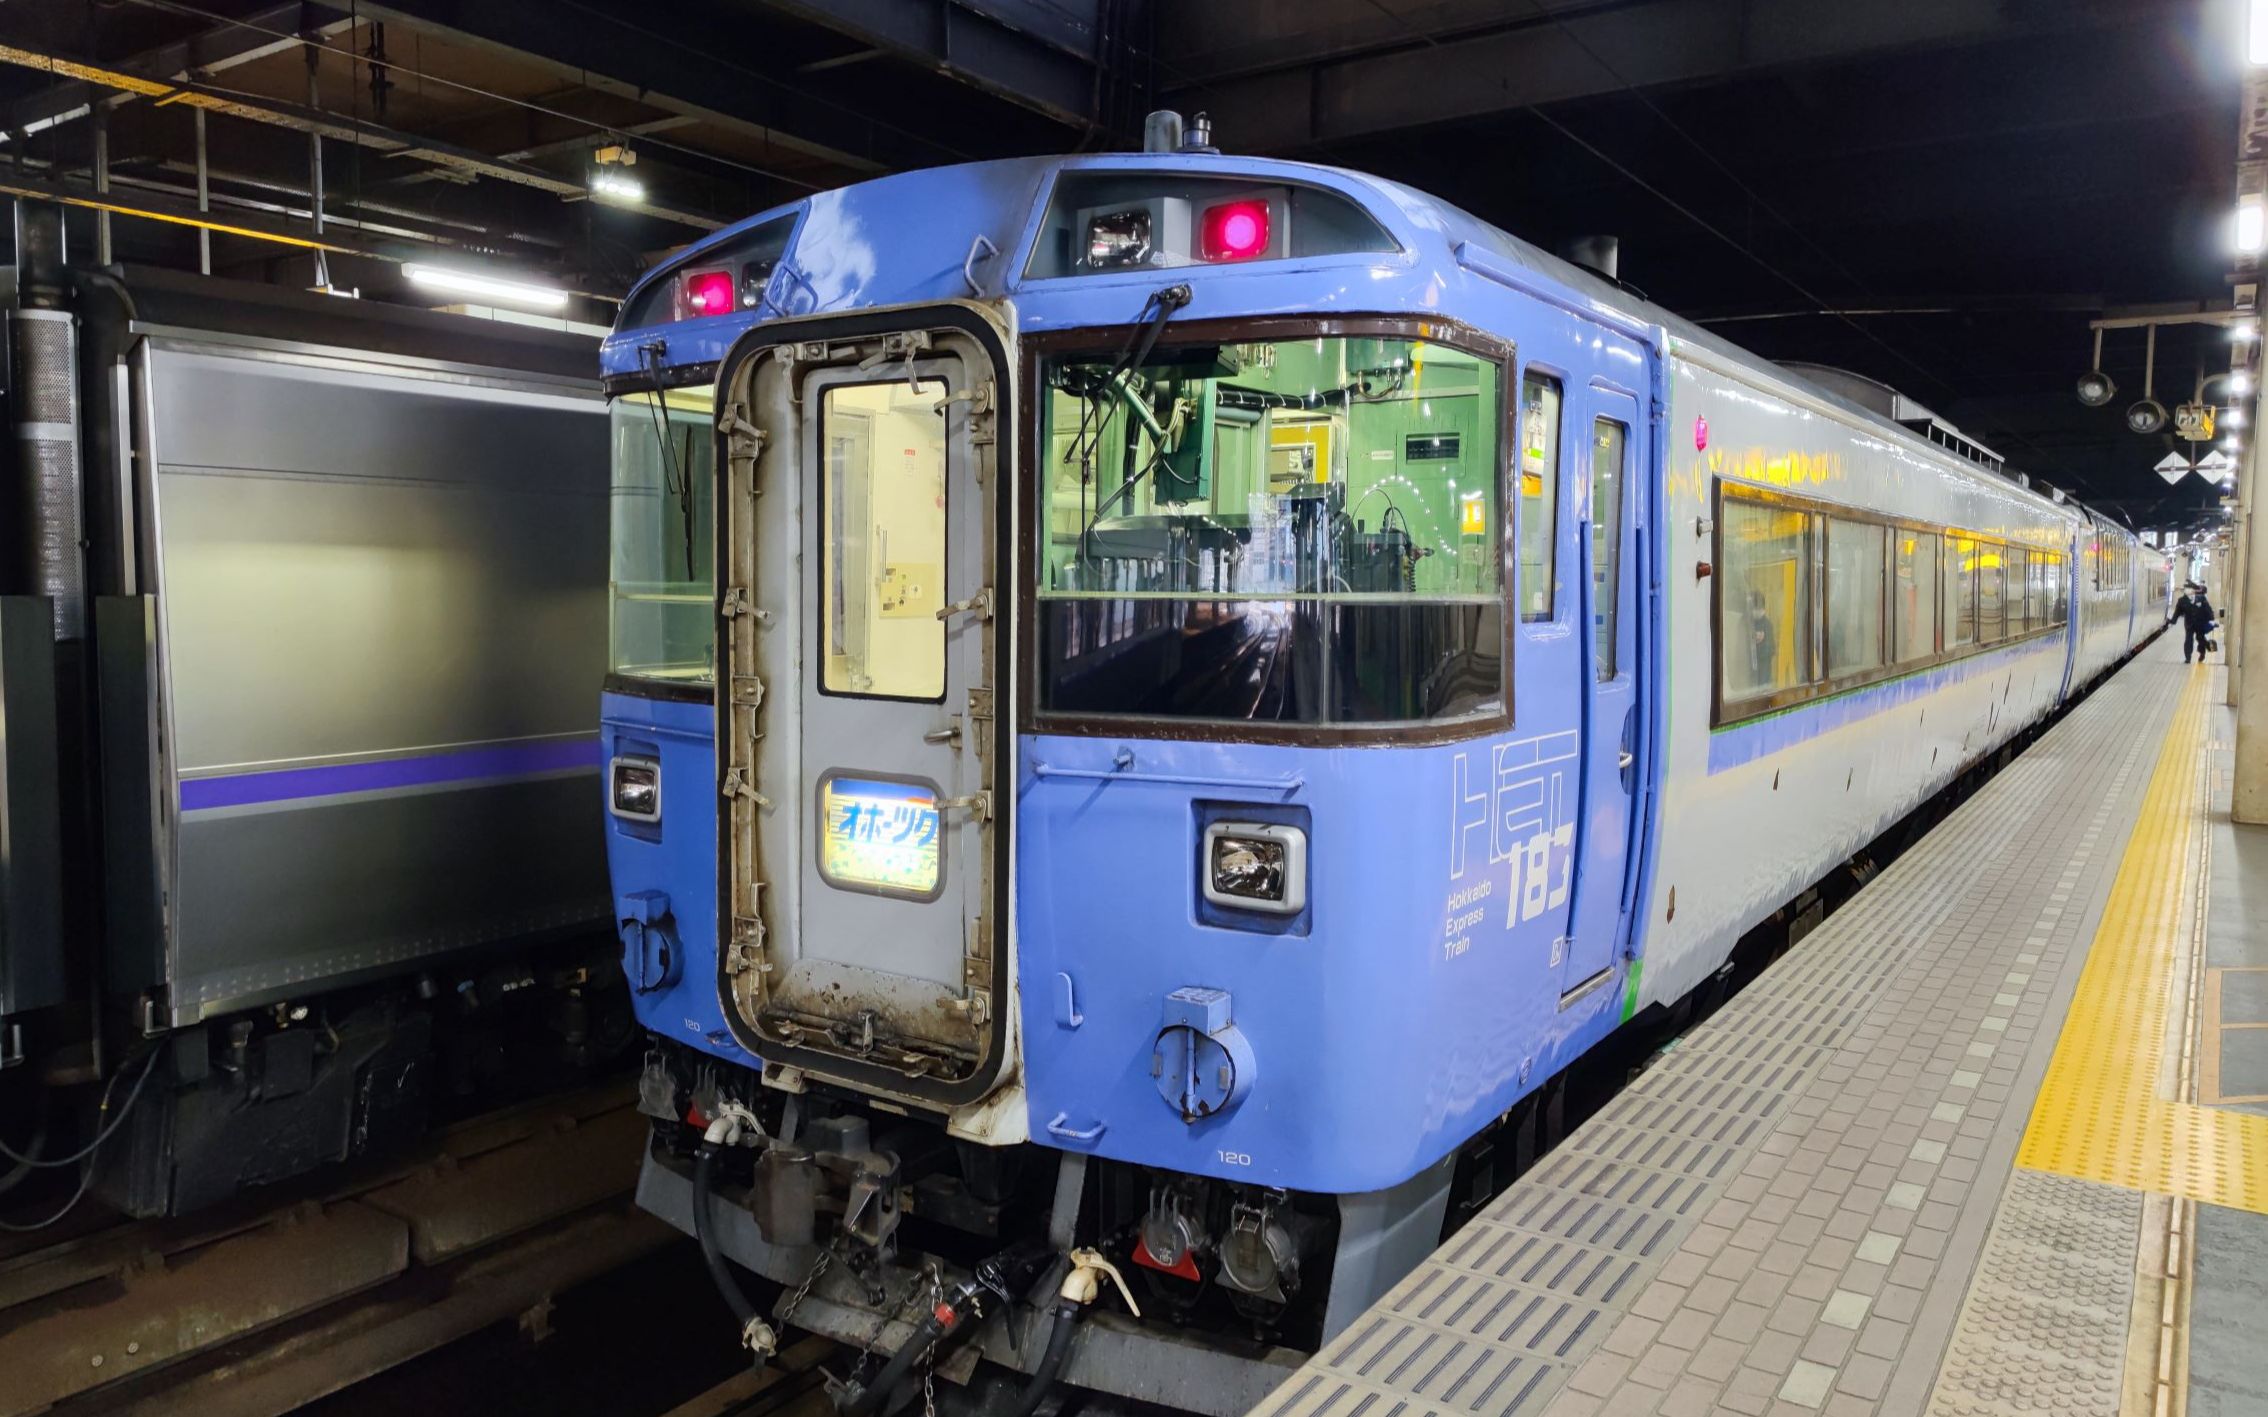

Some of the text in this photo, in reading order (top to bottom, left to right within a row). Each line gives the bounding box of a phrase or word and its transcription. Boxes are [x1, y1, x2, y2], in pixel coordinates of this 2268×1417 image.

[838, 800, 939, 848] オホーツク
[1505, 821, 1574, 931] 183
[1447, 879, 1492, 914] Hokkaido
[1445, 907, 1484, 938] Express
[1444, 935, 1470, 961] Train
[683, 1017, 701, 1032] 120
[1217, 1150, 1251, 1166] 120
